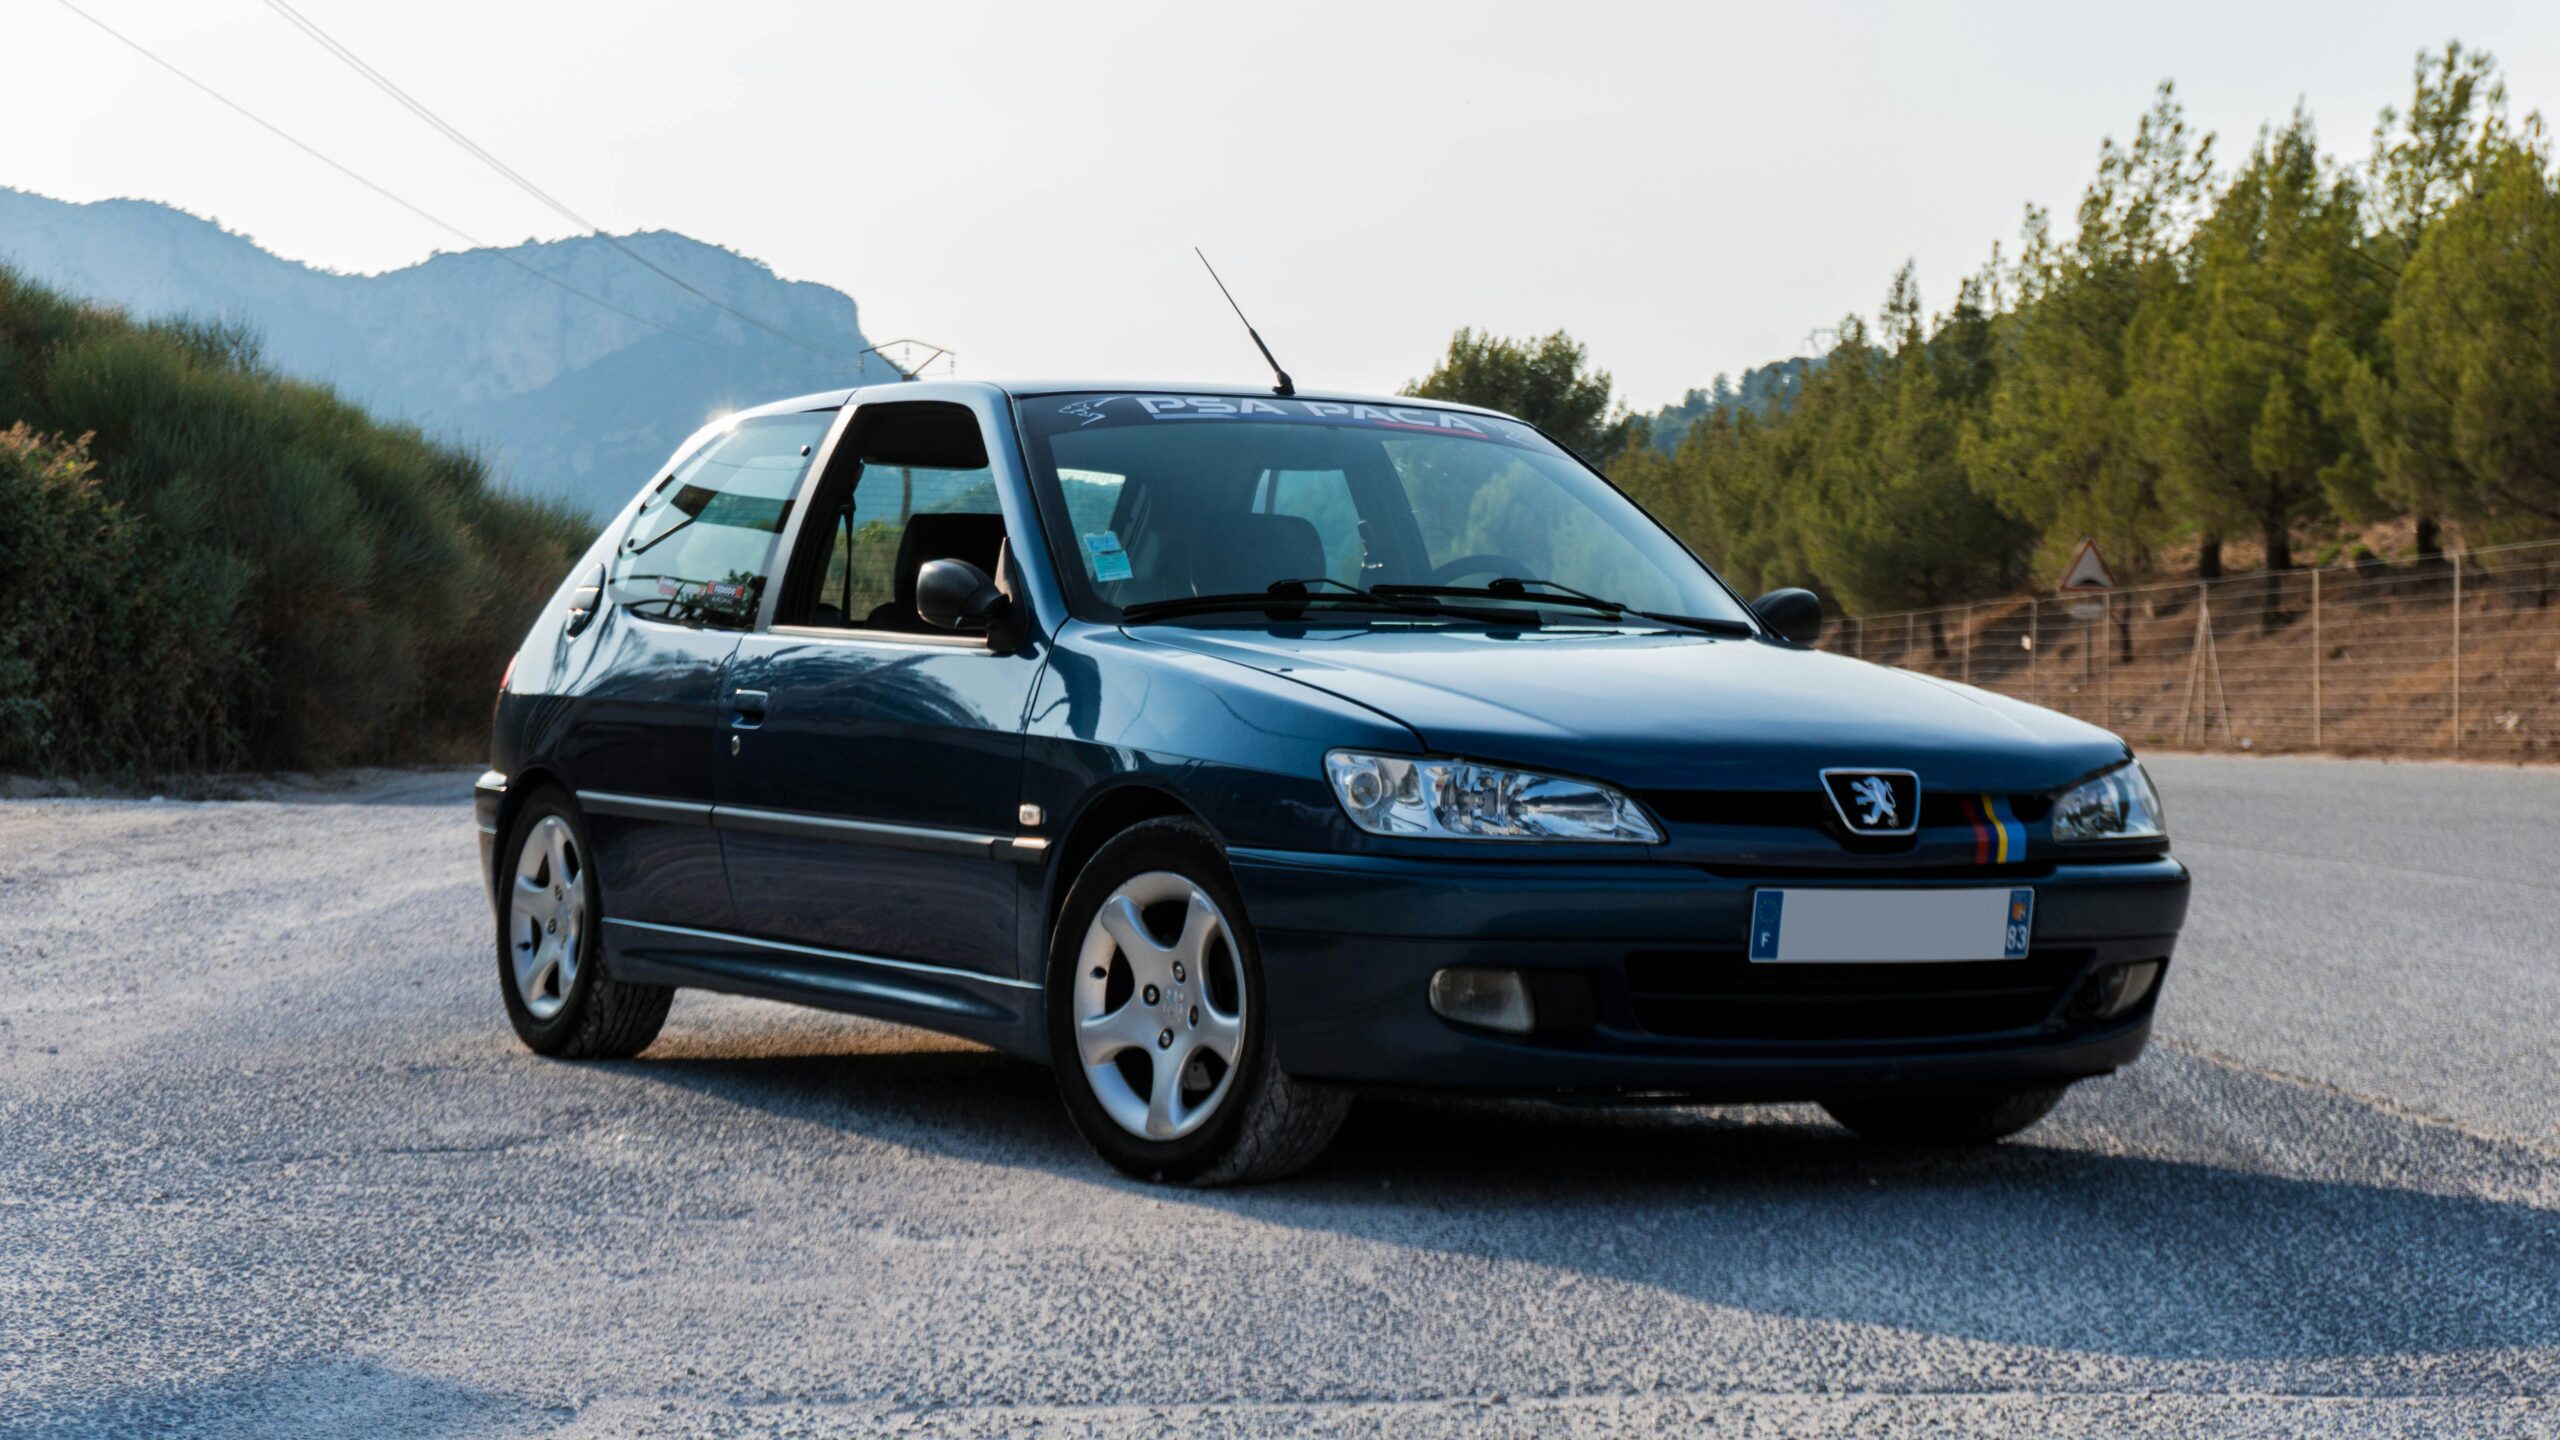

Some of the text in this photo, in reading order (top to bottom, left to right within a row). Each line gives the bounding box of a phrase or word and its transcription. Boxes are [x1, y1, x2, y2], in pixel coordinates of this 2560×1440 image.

[1135, 397, 1484, 433] PSA PACA
[1761, 931, 1771, 948] F
[2007, 924, 2028, 950] 83
